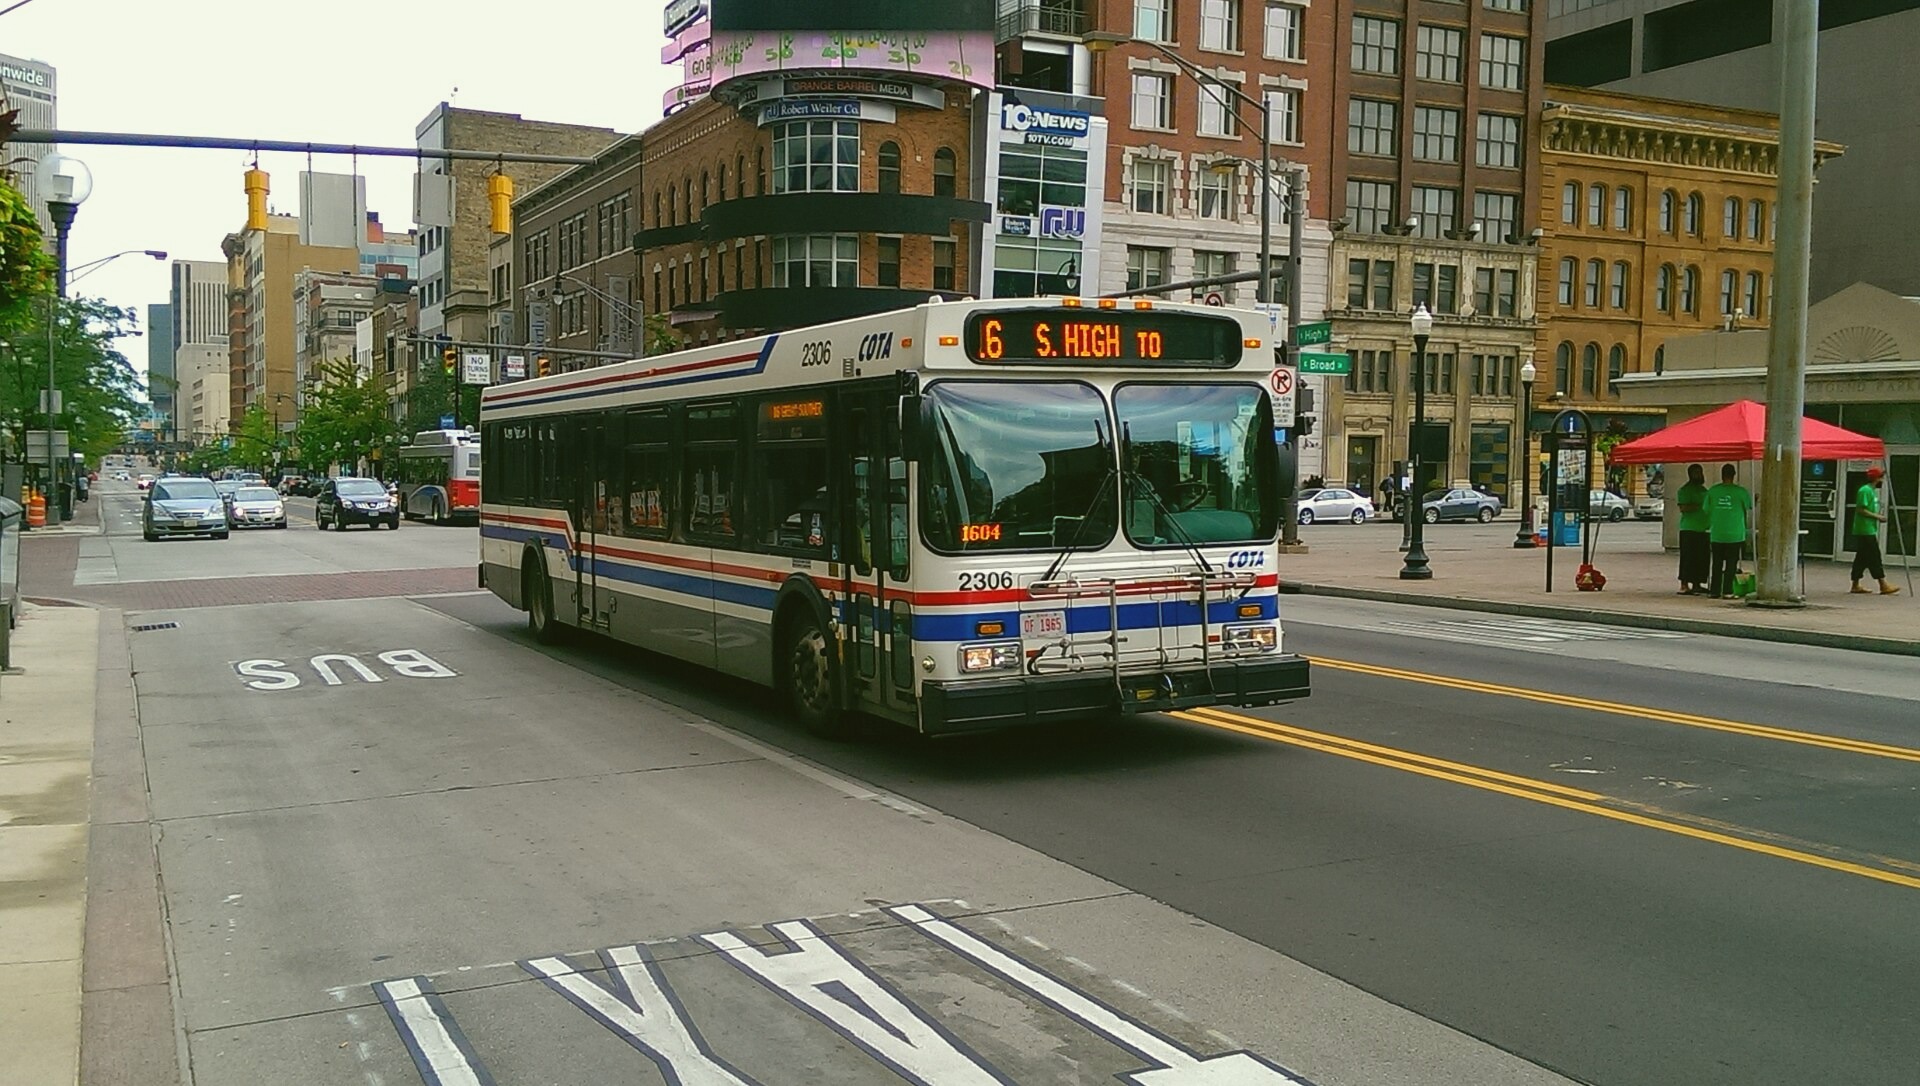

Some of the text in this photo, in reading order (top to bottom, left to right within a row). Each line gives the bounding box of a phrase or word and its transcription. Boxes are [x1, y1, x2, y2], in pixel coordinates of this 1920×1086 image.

[0, 67, 43, 86] nwide
[792, 81, 909, 95] ORANGE BARREL MEDIA
[781, 104, 808, 116] Robert
[811, 103, 844, 114] Weiler
[1003, 103, 1032, 130] 10
[1028, 134, 1073, 146] 10TV.COM
[1065, 324, 1120, 357] HIGH
[1137, 332, 1161, 358] TO
[1305, 329, 1322, 342] High
[802, 340, 831, 367] 2306
[858, 332, 893, 361] COTA
[471, 357, 483, 365] NO
[1310, 359, 1335, 370] Broad
[1876, 379, 1920, 391] PARK
[962, 524, 1001, 542] 1604
[1228, 551, 1264, 568] COTA
[959, 571, 1013, 591] 2306
[1041, 617, 1062, 631] 1965
[238, 649, 458, 691] BUS
